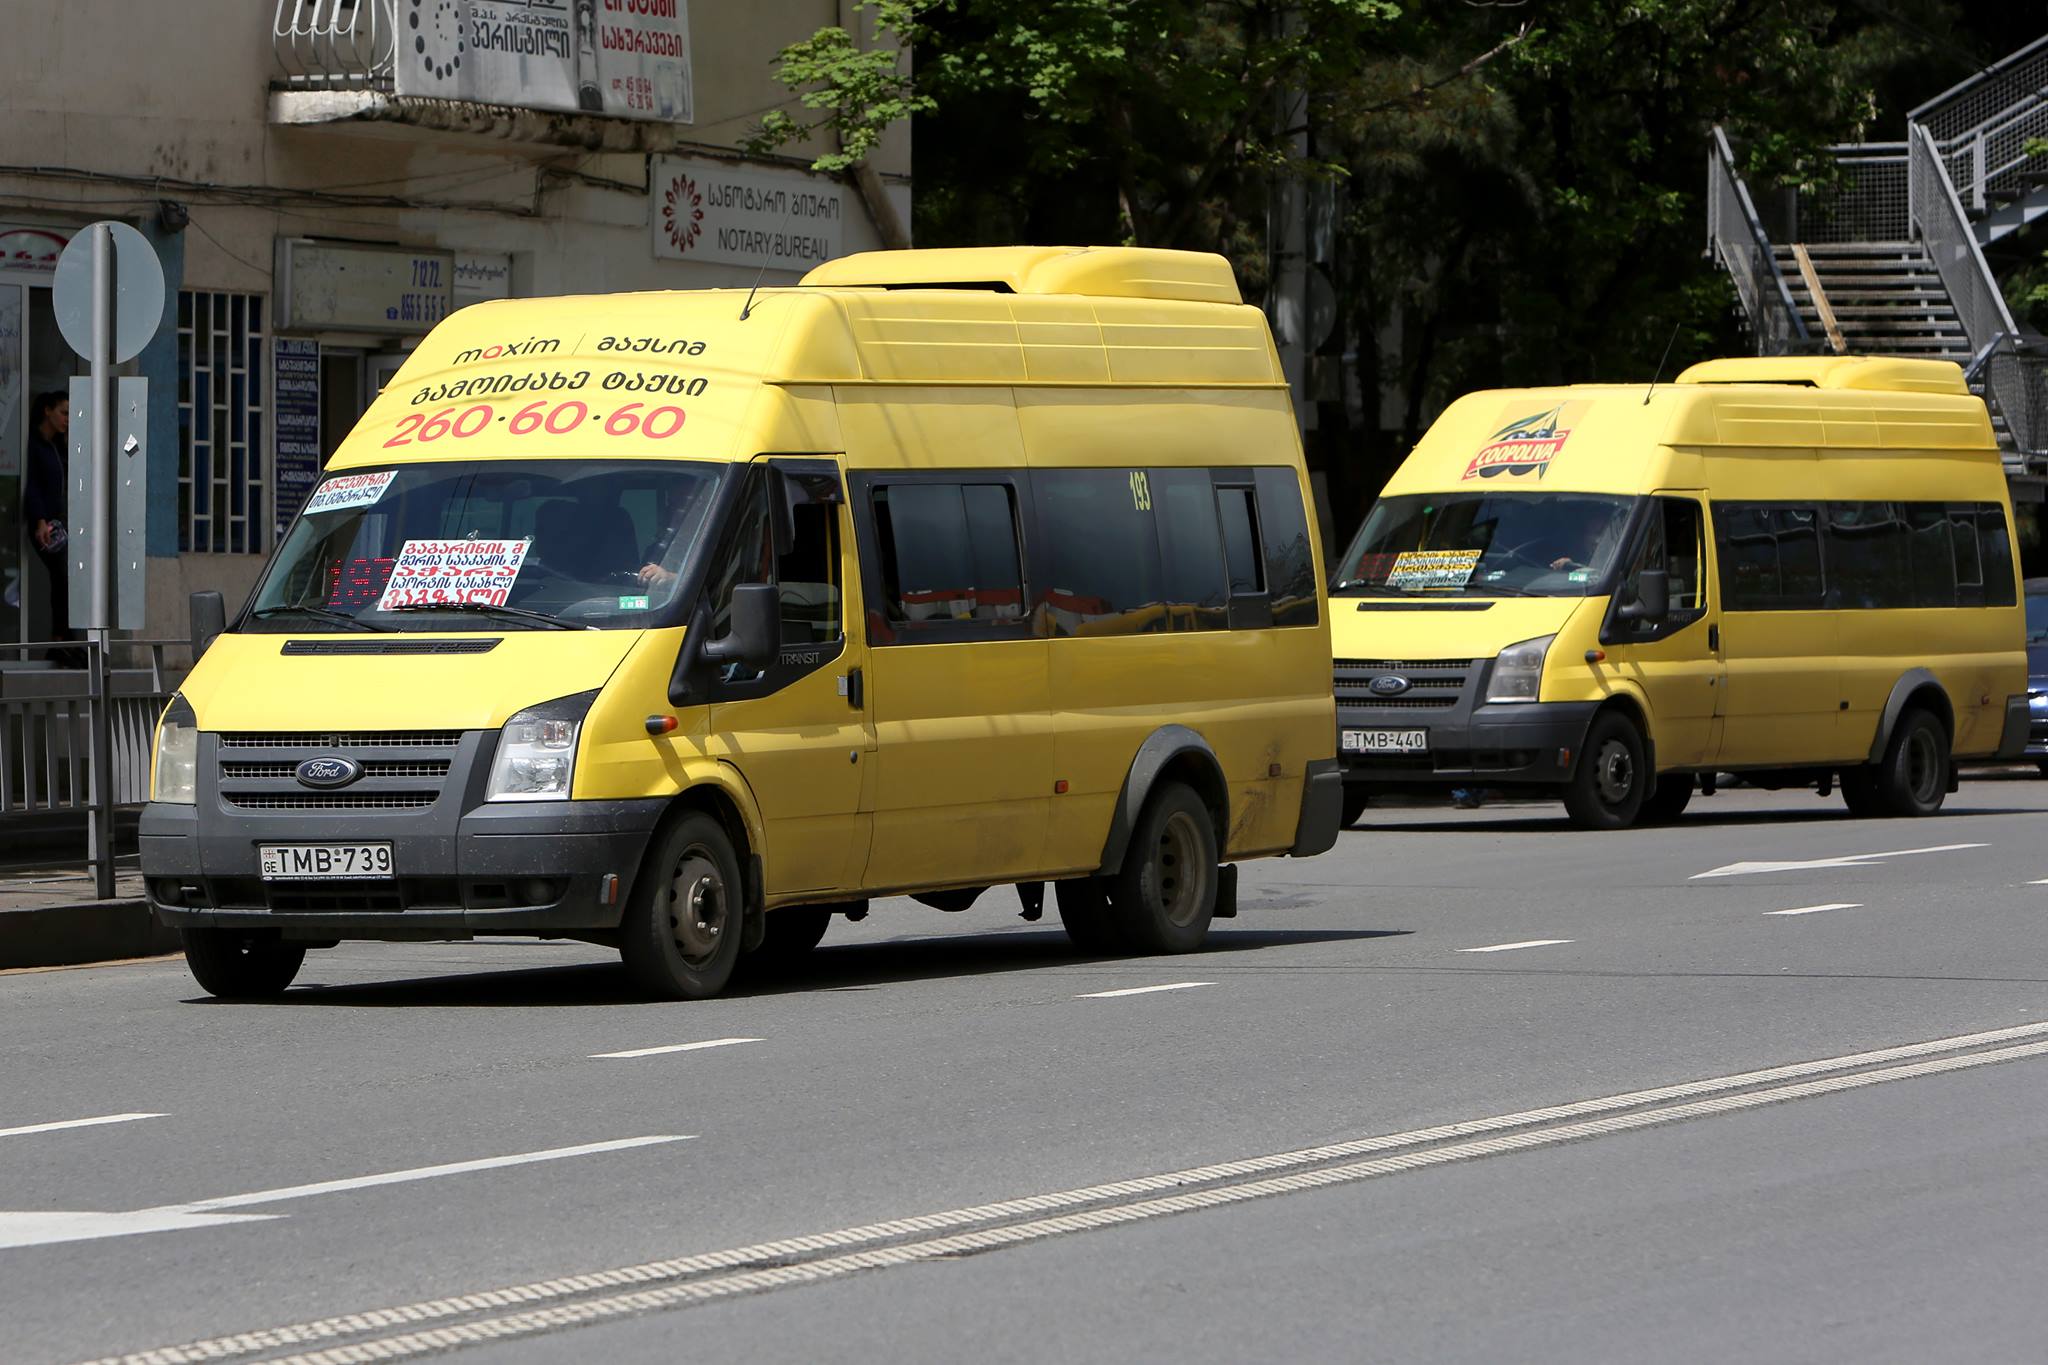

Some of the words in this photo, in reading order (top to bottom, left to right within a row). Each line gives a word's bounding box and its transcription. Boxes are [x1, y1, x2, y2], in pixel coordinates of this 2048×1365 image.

[471, 20, 571, 58] პერისტილი
[601, 25, 684, 57] სახურავები
[708, 183, 787, 215] სანოტარო
[791, 193, 840, 220] ბიურო
[718, 228, 773, 254] NOTARY
[774, 235, 829, 261] BUREAU
[452, 336, 561, 365] maxim
[597, 336, 707, 356] მაქსიმ
[410, 370, 591, 406] გამოიძახე
[601, 371, 709, 397] ტაქსი
[1475, 442, 1557, 466] COOPOLIVA
[319, 472, 391, 493] ტელევიზია
[1129, 471, 1151, 511] 193
[405, 542, 506, 555] გაგარინის
[400, 554, 442, 566] მერია
[445, 554, 507, 566] სააკაძის
[396, 566, 516, 577] აჭარა
[391, 577, 451, 589] სპორტის
[455, 577, 513, 589] სასახლე
[780, 652, 820, 665] TRANSIT
[308, 762, 341, 777] Ford
[264, 861, 277, 873] GE
[277, 848, 391, 873] TMB-739
